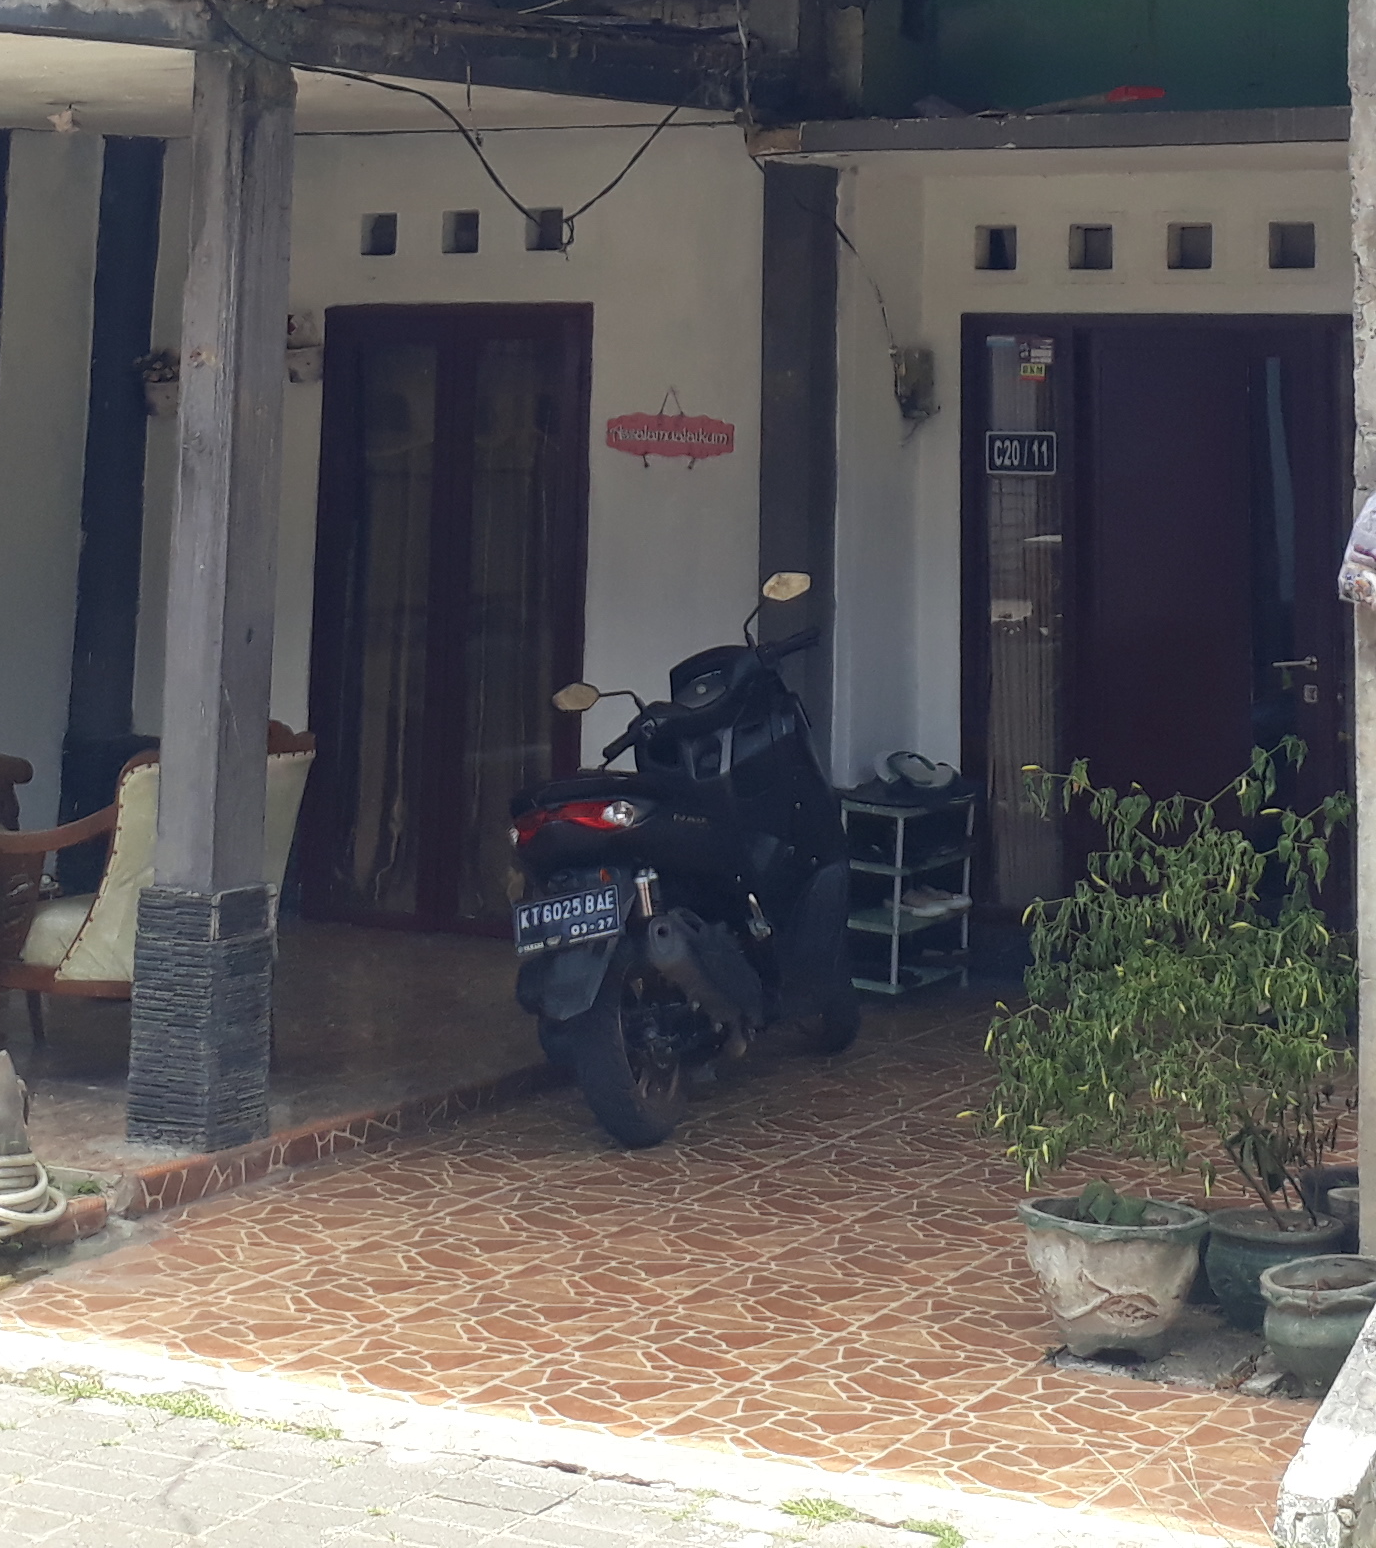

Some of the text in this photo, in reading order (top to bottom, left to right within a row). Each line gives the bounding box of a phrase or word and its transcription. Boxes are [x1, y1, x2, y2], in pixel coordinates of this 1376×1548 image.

[520, 890, 614, 930] KT 6025 BAE
